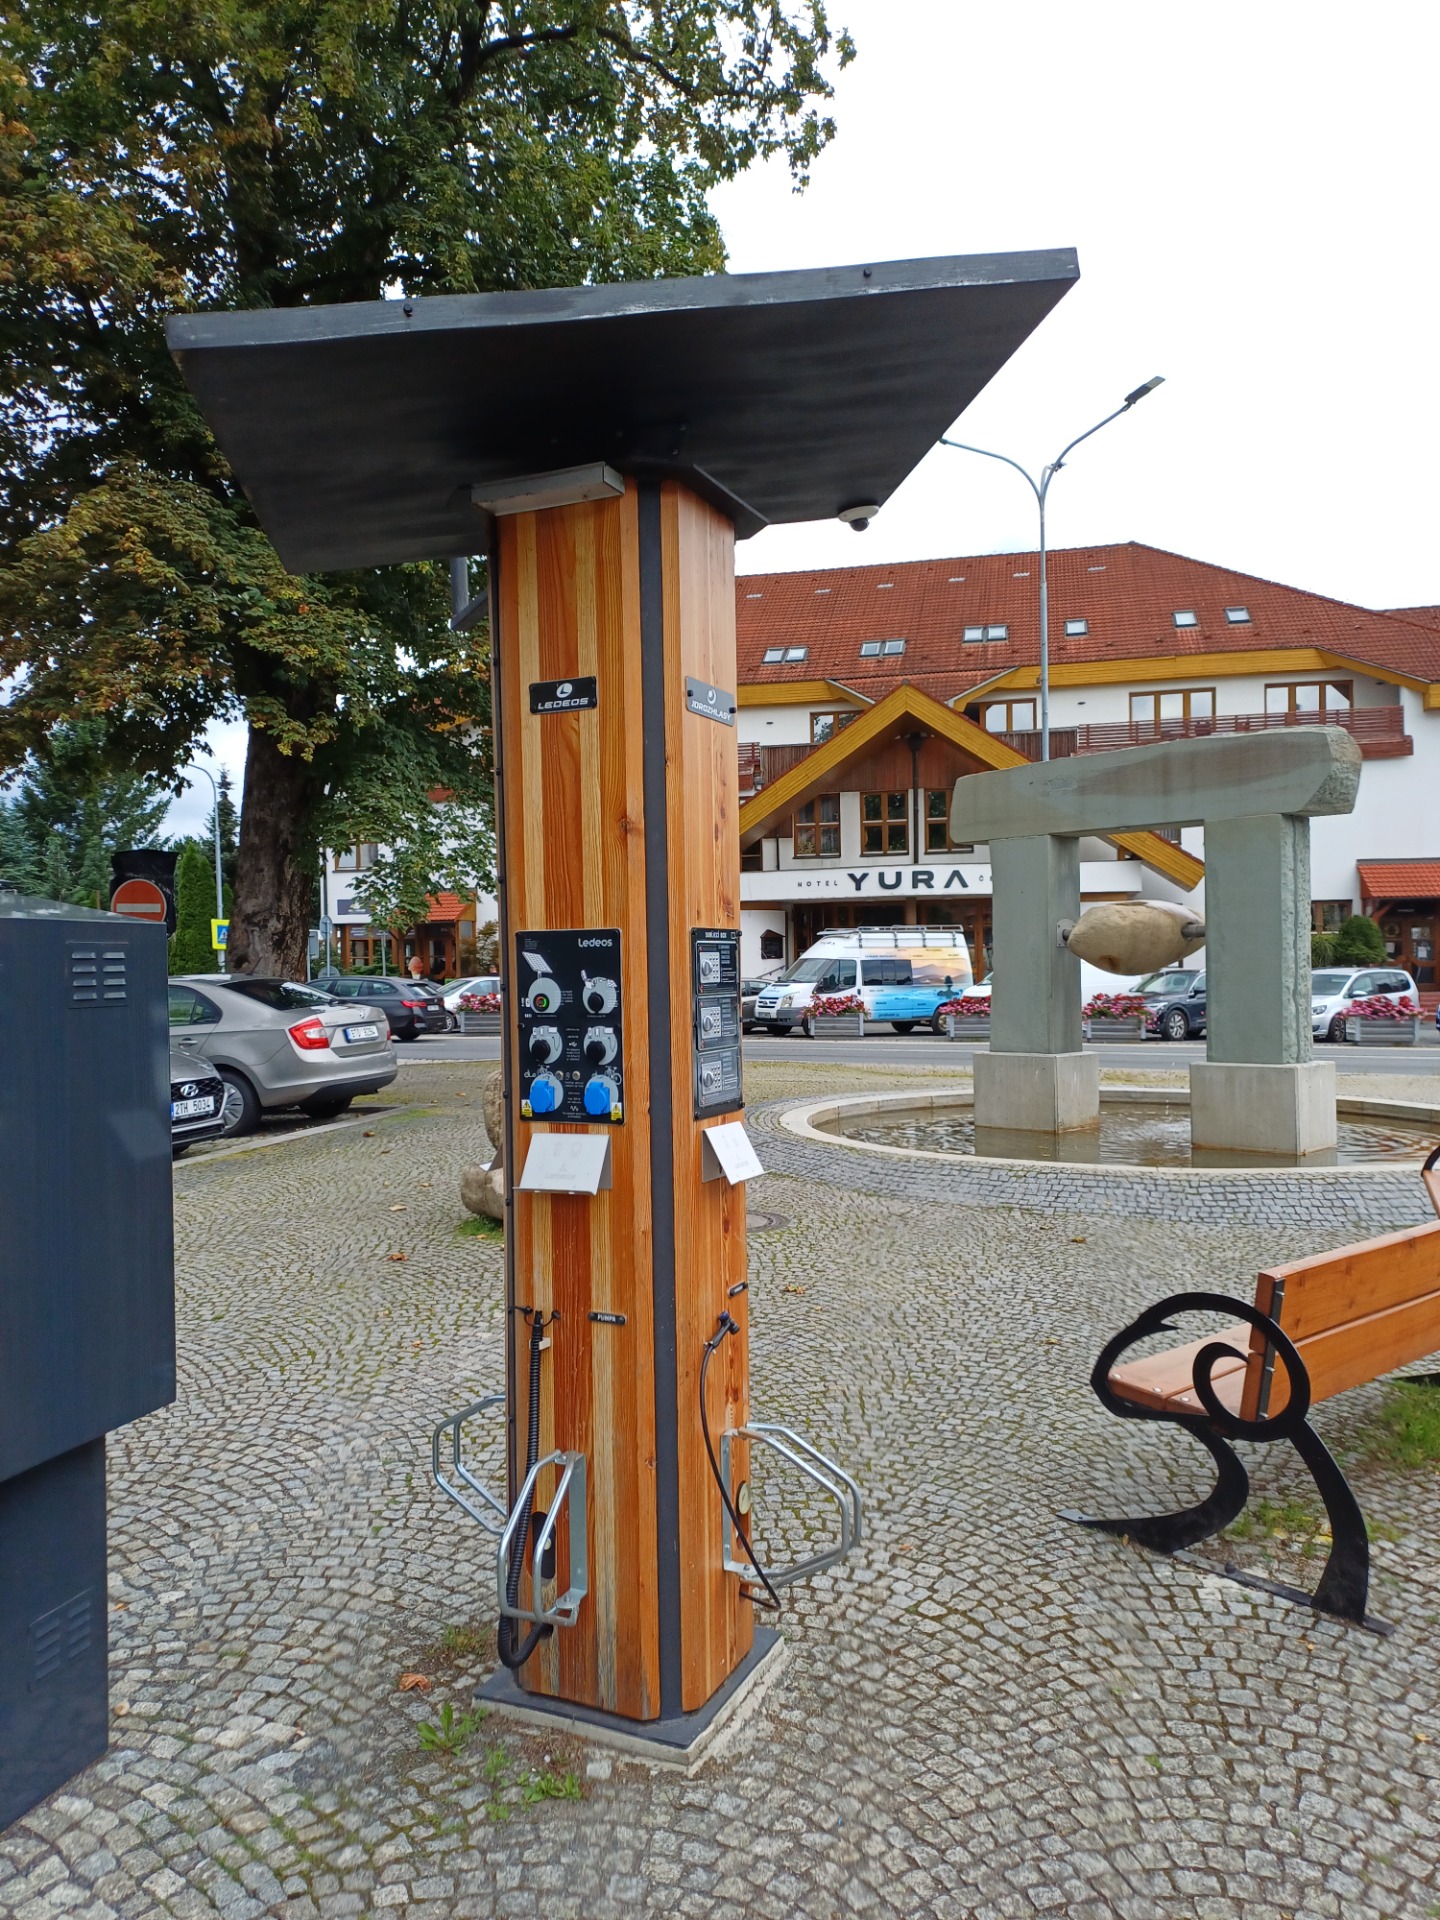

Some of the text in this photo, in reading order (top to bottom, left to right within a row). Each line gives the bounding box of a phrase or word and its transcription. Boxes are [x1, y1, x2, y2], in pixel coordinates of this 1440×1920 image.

[538, 697, 589, 710] LEDEOS
[797, 879, 838, 888] HOTEL
[847, 869, 969, 892] YURA
[577, 937, 613, 948] Ledeos
[175, 1098, 211, 1115] 2TH 5034
